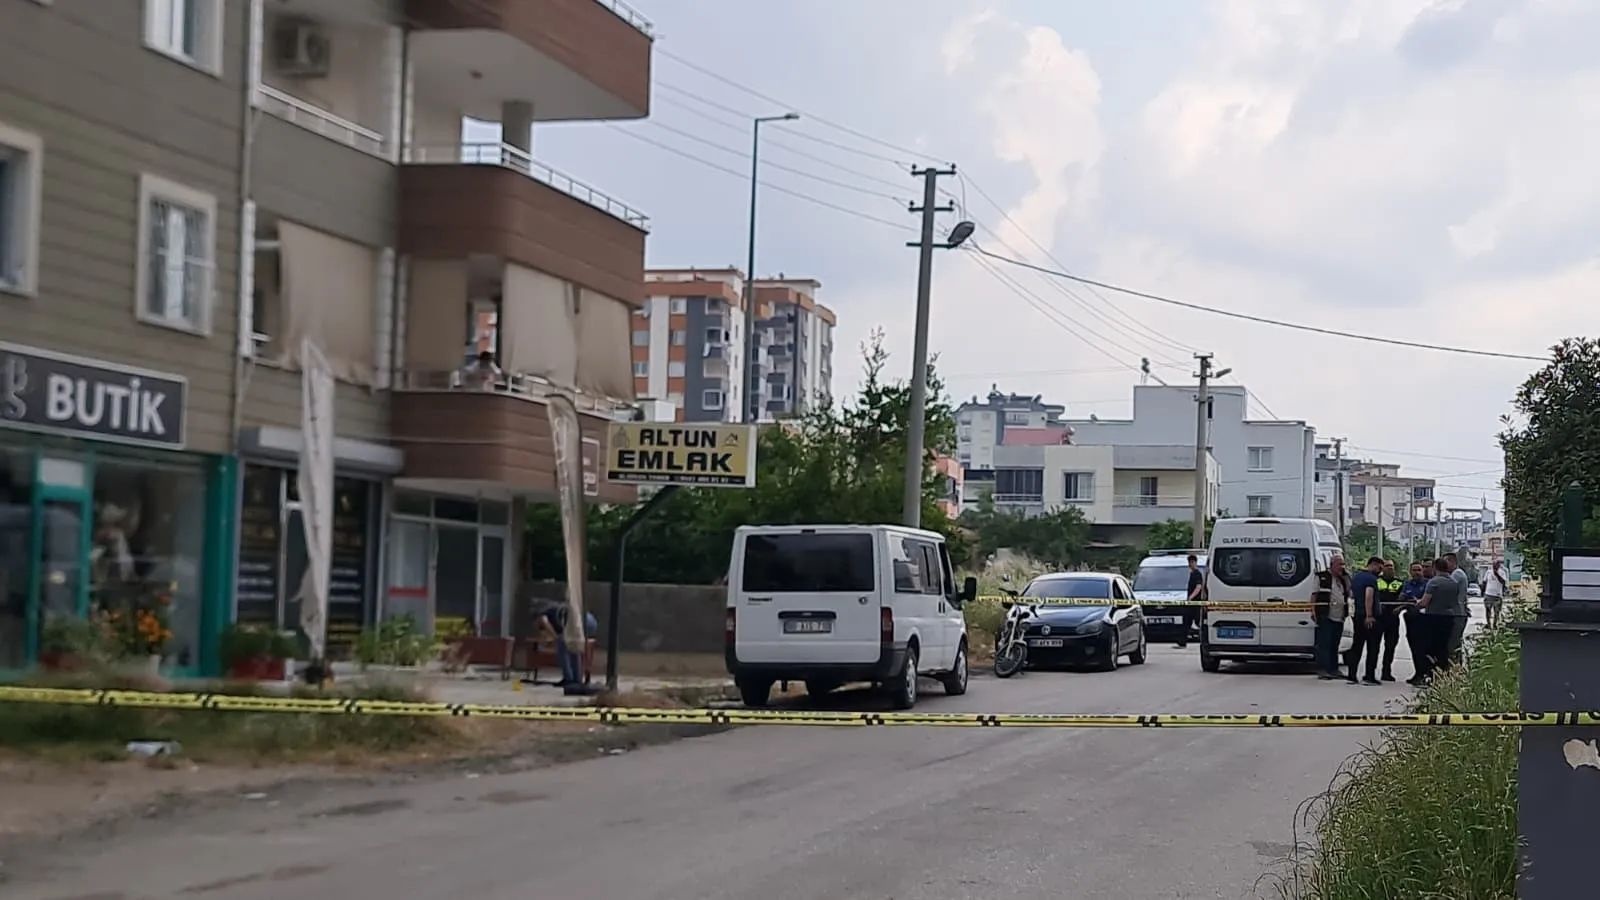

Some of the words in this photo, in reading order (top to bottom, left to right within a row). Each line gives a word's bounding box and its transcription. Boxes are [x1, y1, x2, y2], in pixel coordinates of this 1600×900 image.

[46, 373, 166, 435] BUTİK
[639, 429, 717, 448] ALTUN
[617, 450, 733, 472] EMLAK
